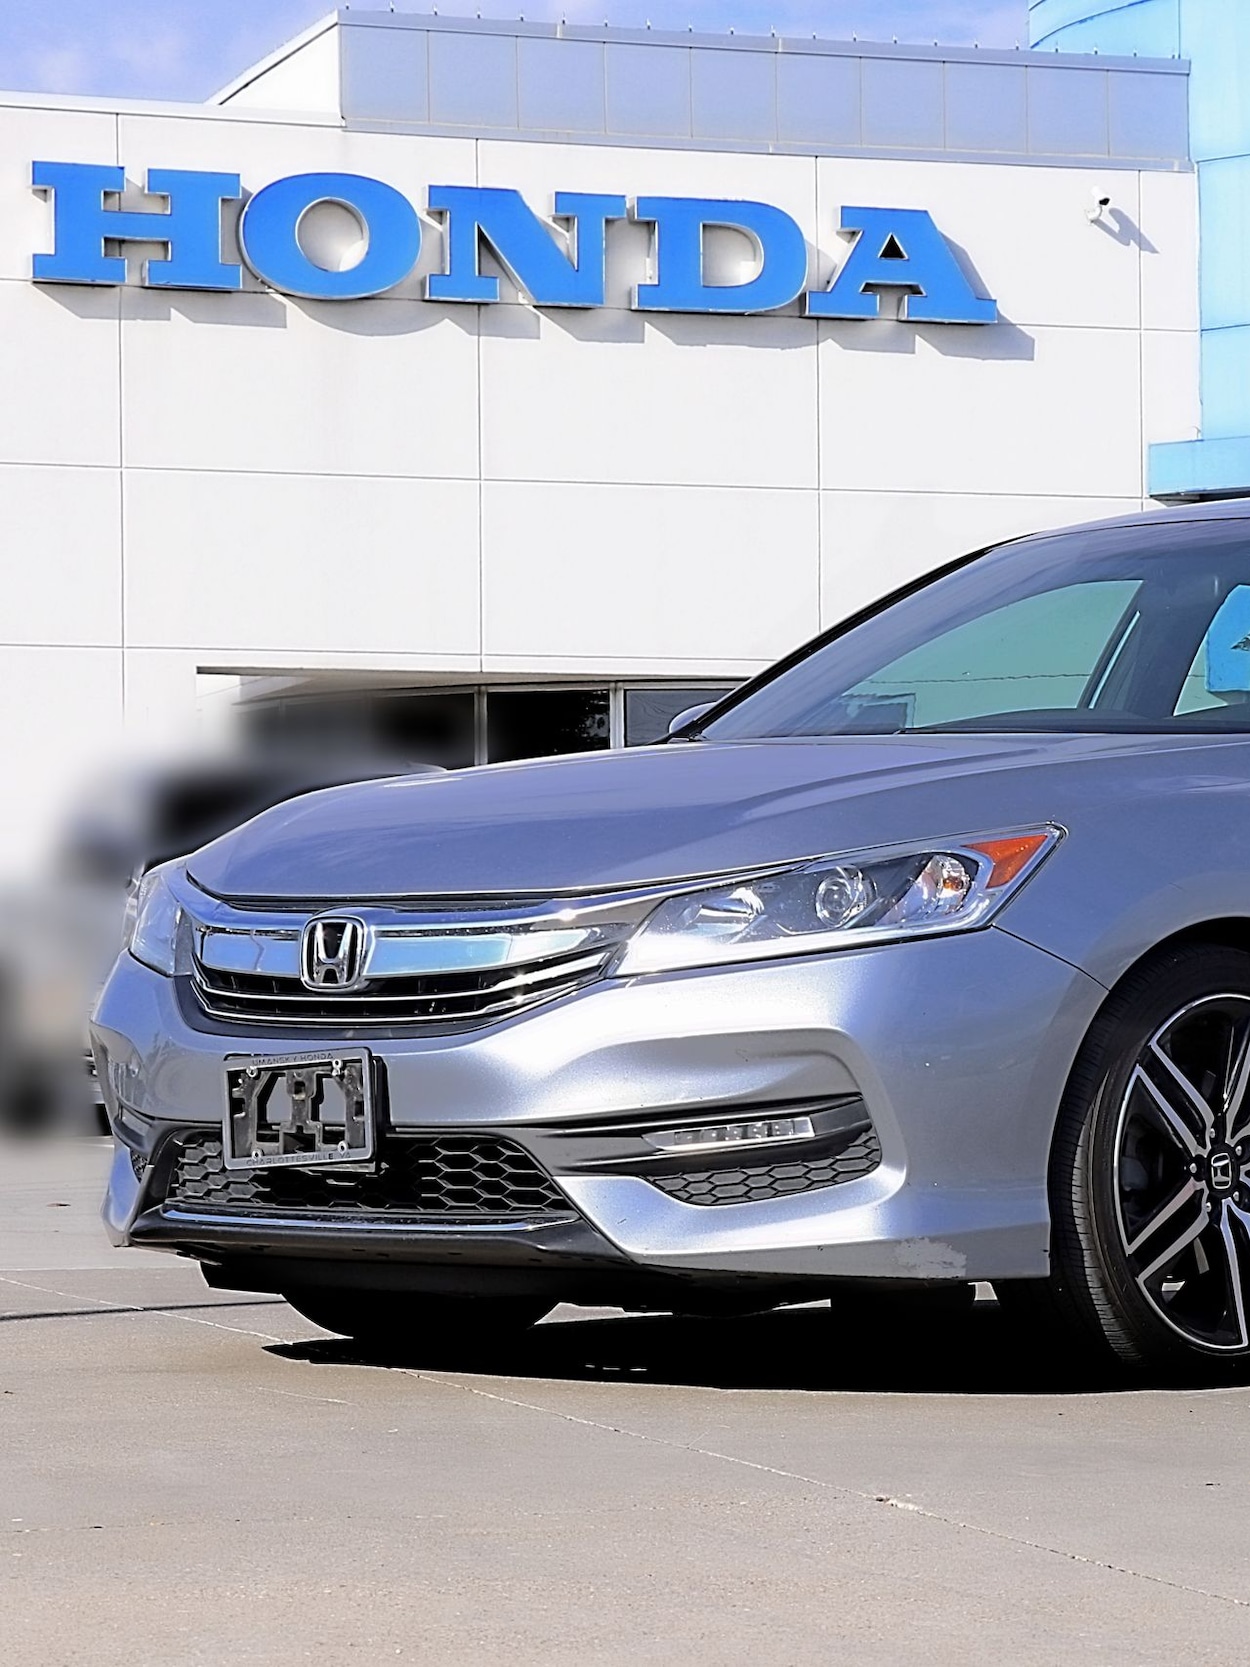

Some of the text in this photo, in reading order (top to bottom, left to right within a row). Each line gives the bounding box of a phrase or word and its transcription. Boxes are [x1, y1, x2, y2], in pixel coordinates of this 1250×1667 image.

[30, 160, 999, 325] HONDA
[252, 1052, 334, 1066] UMANSKY HONDA
[246, 1152, 334, 1166] CHARLOTTESVILLE
